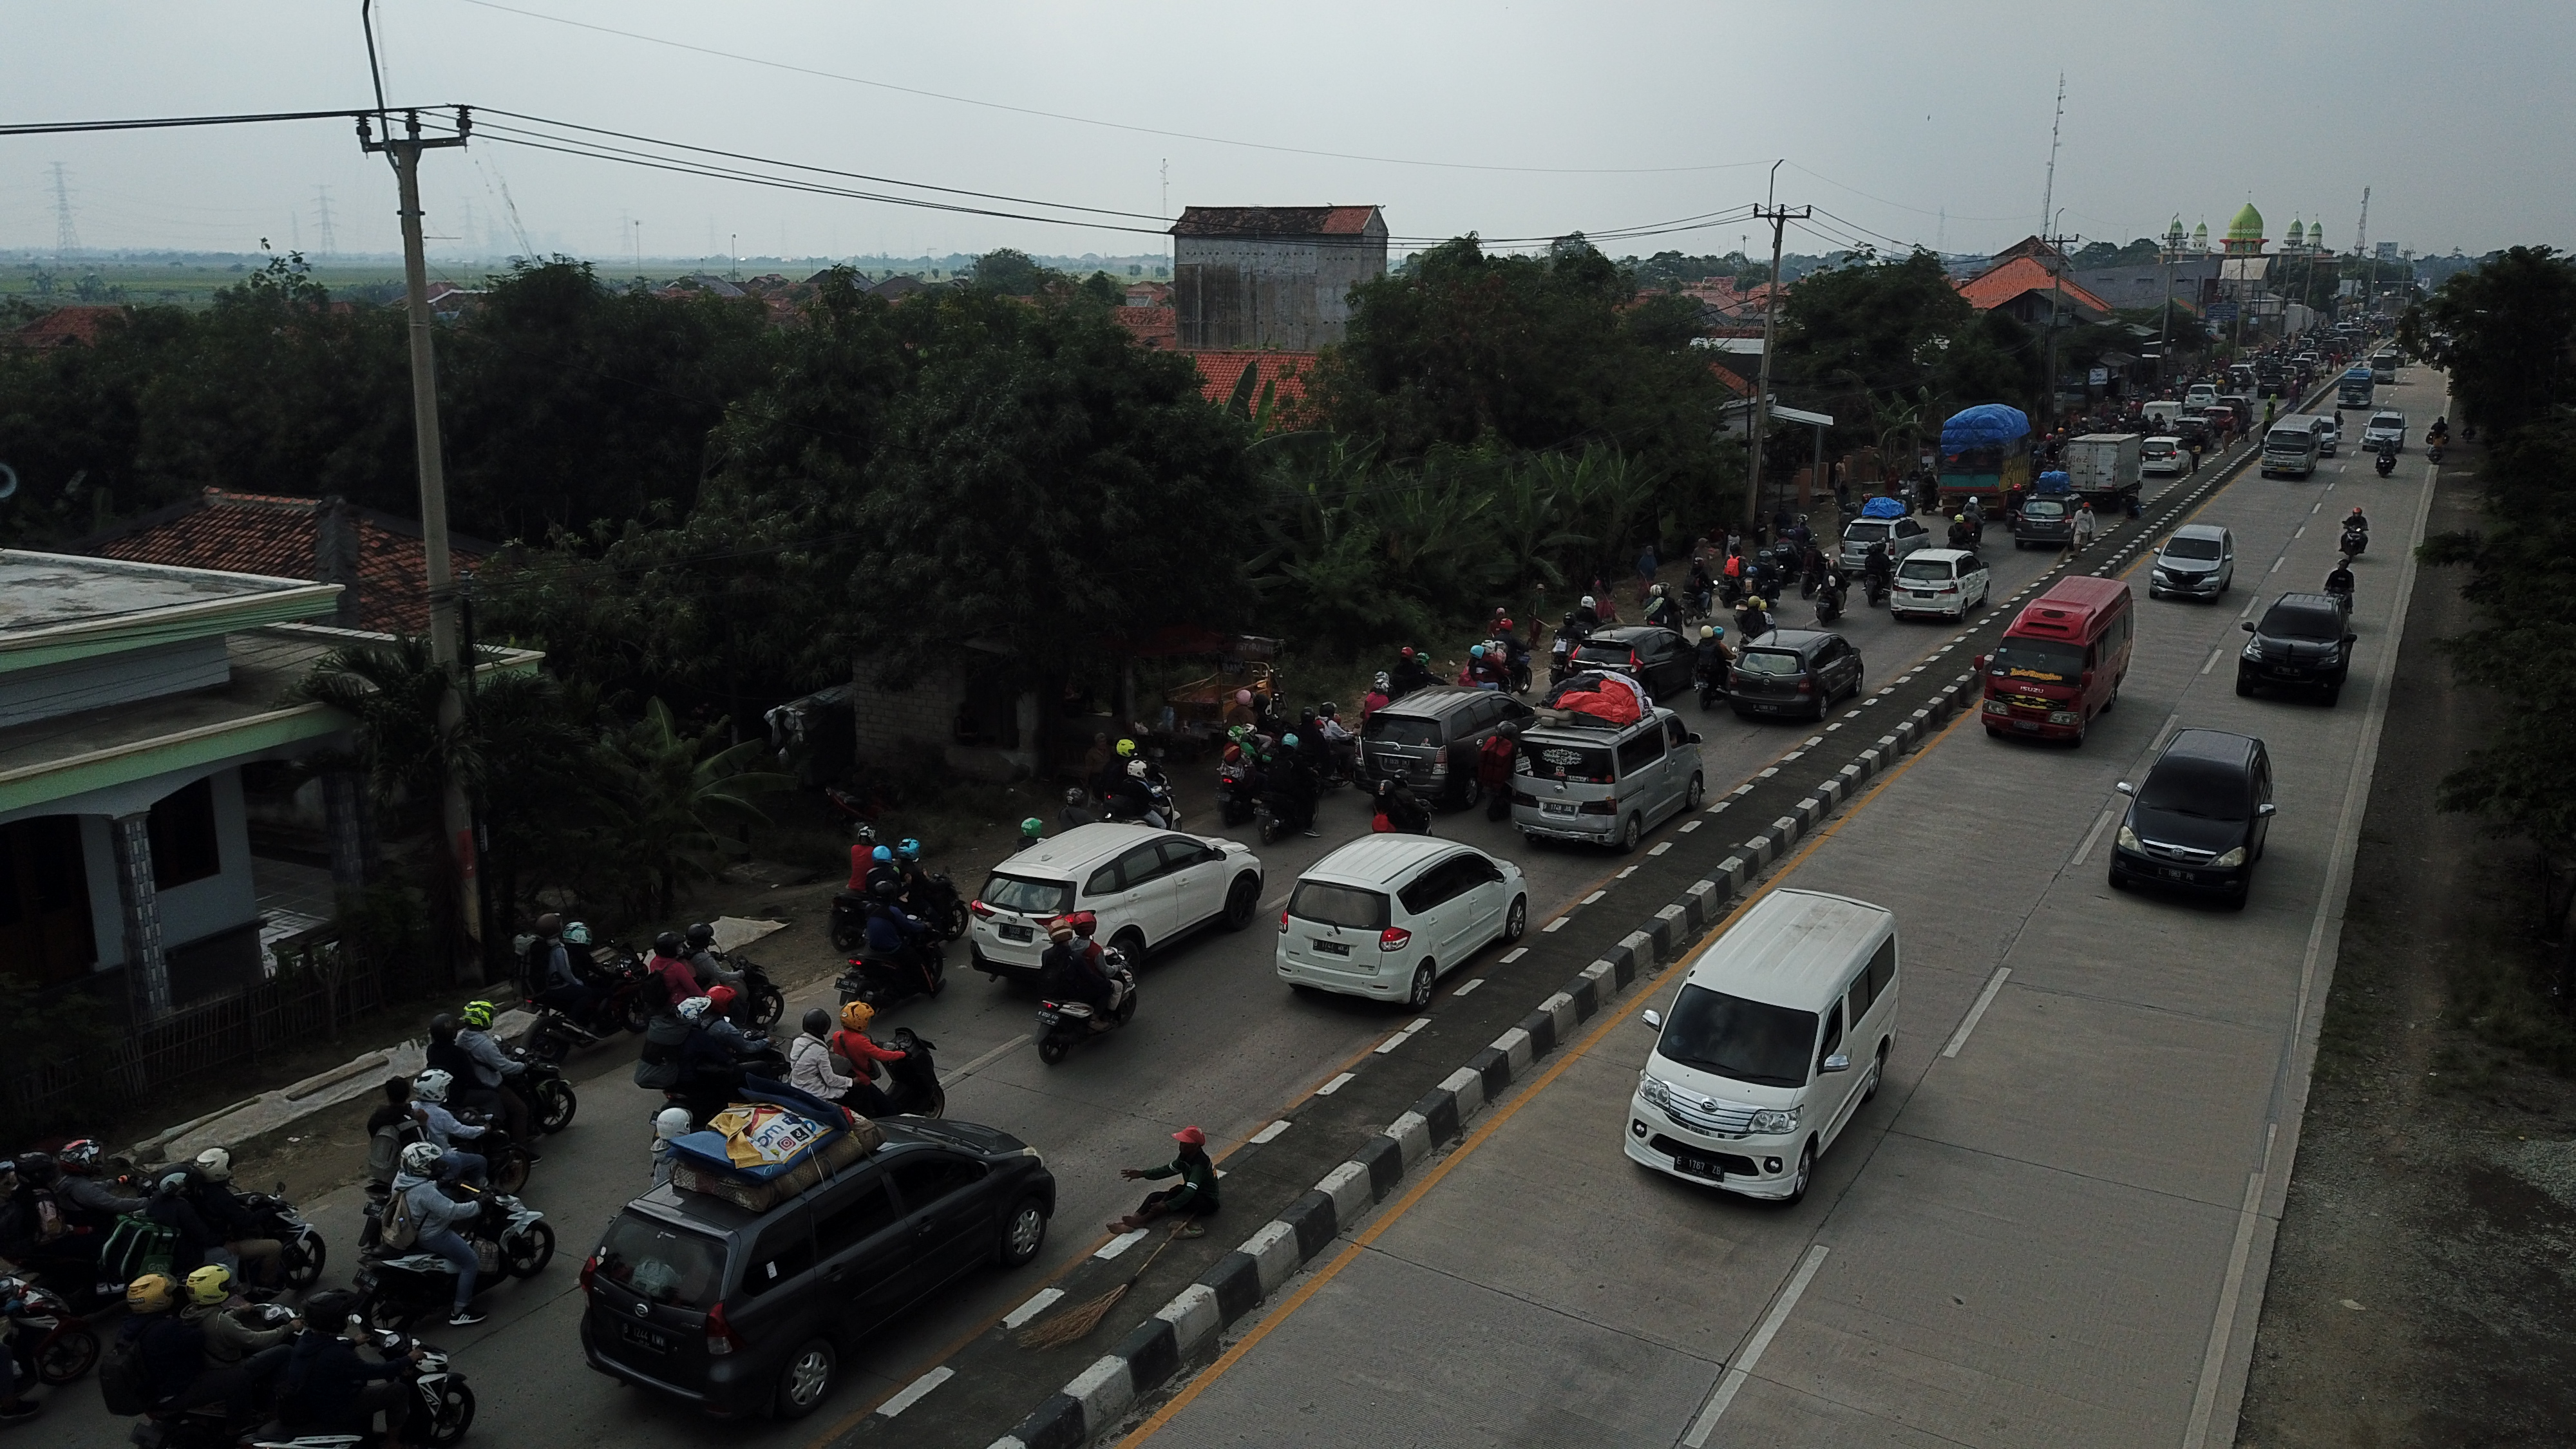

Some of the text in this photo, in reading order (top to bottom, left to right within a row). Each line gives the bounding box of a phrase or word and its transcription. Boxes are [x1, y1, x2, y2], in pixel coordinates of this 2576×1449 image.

[1676, 1155, 1682, 1165] E
[1689, 1159, 1706, 1171] 1767
[623, 1322, 629, 1334] B
